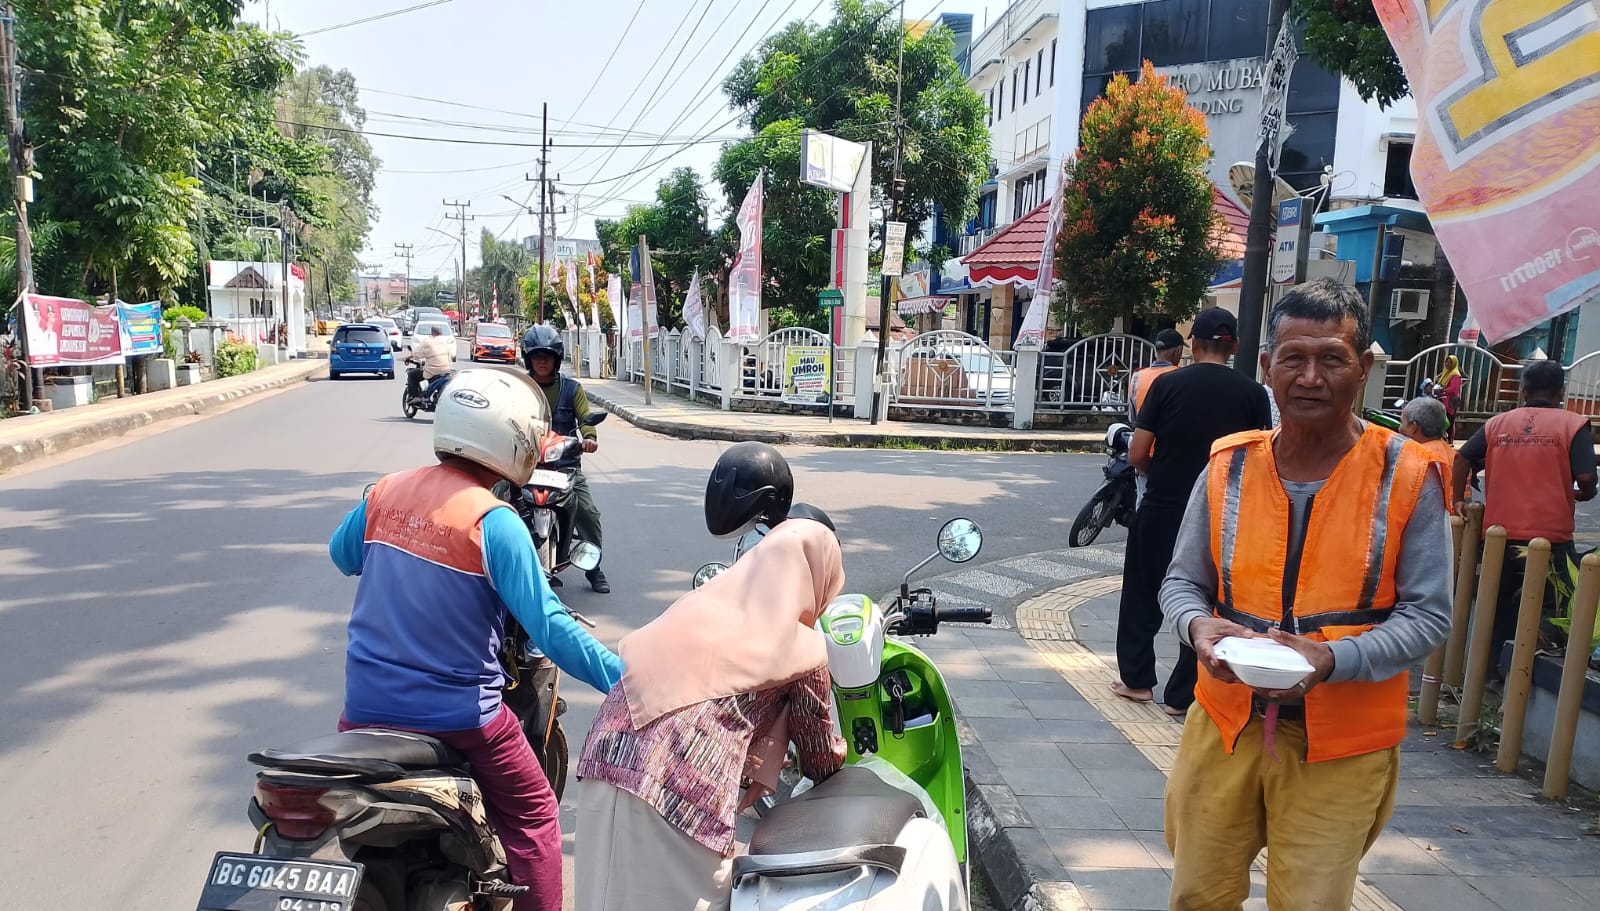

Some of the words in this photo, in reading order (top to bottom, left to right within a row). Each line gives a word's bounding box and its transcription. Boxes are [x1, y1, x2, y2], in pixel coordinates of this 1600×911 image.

[1279, 241, 1295, 253] ATM
[792, 363, 824, 374] UMROH
[247, 866, 302, 891] 6045
[304, 869, 350, 896] BAA
